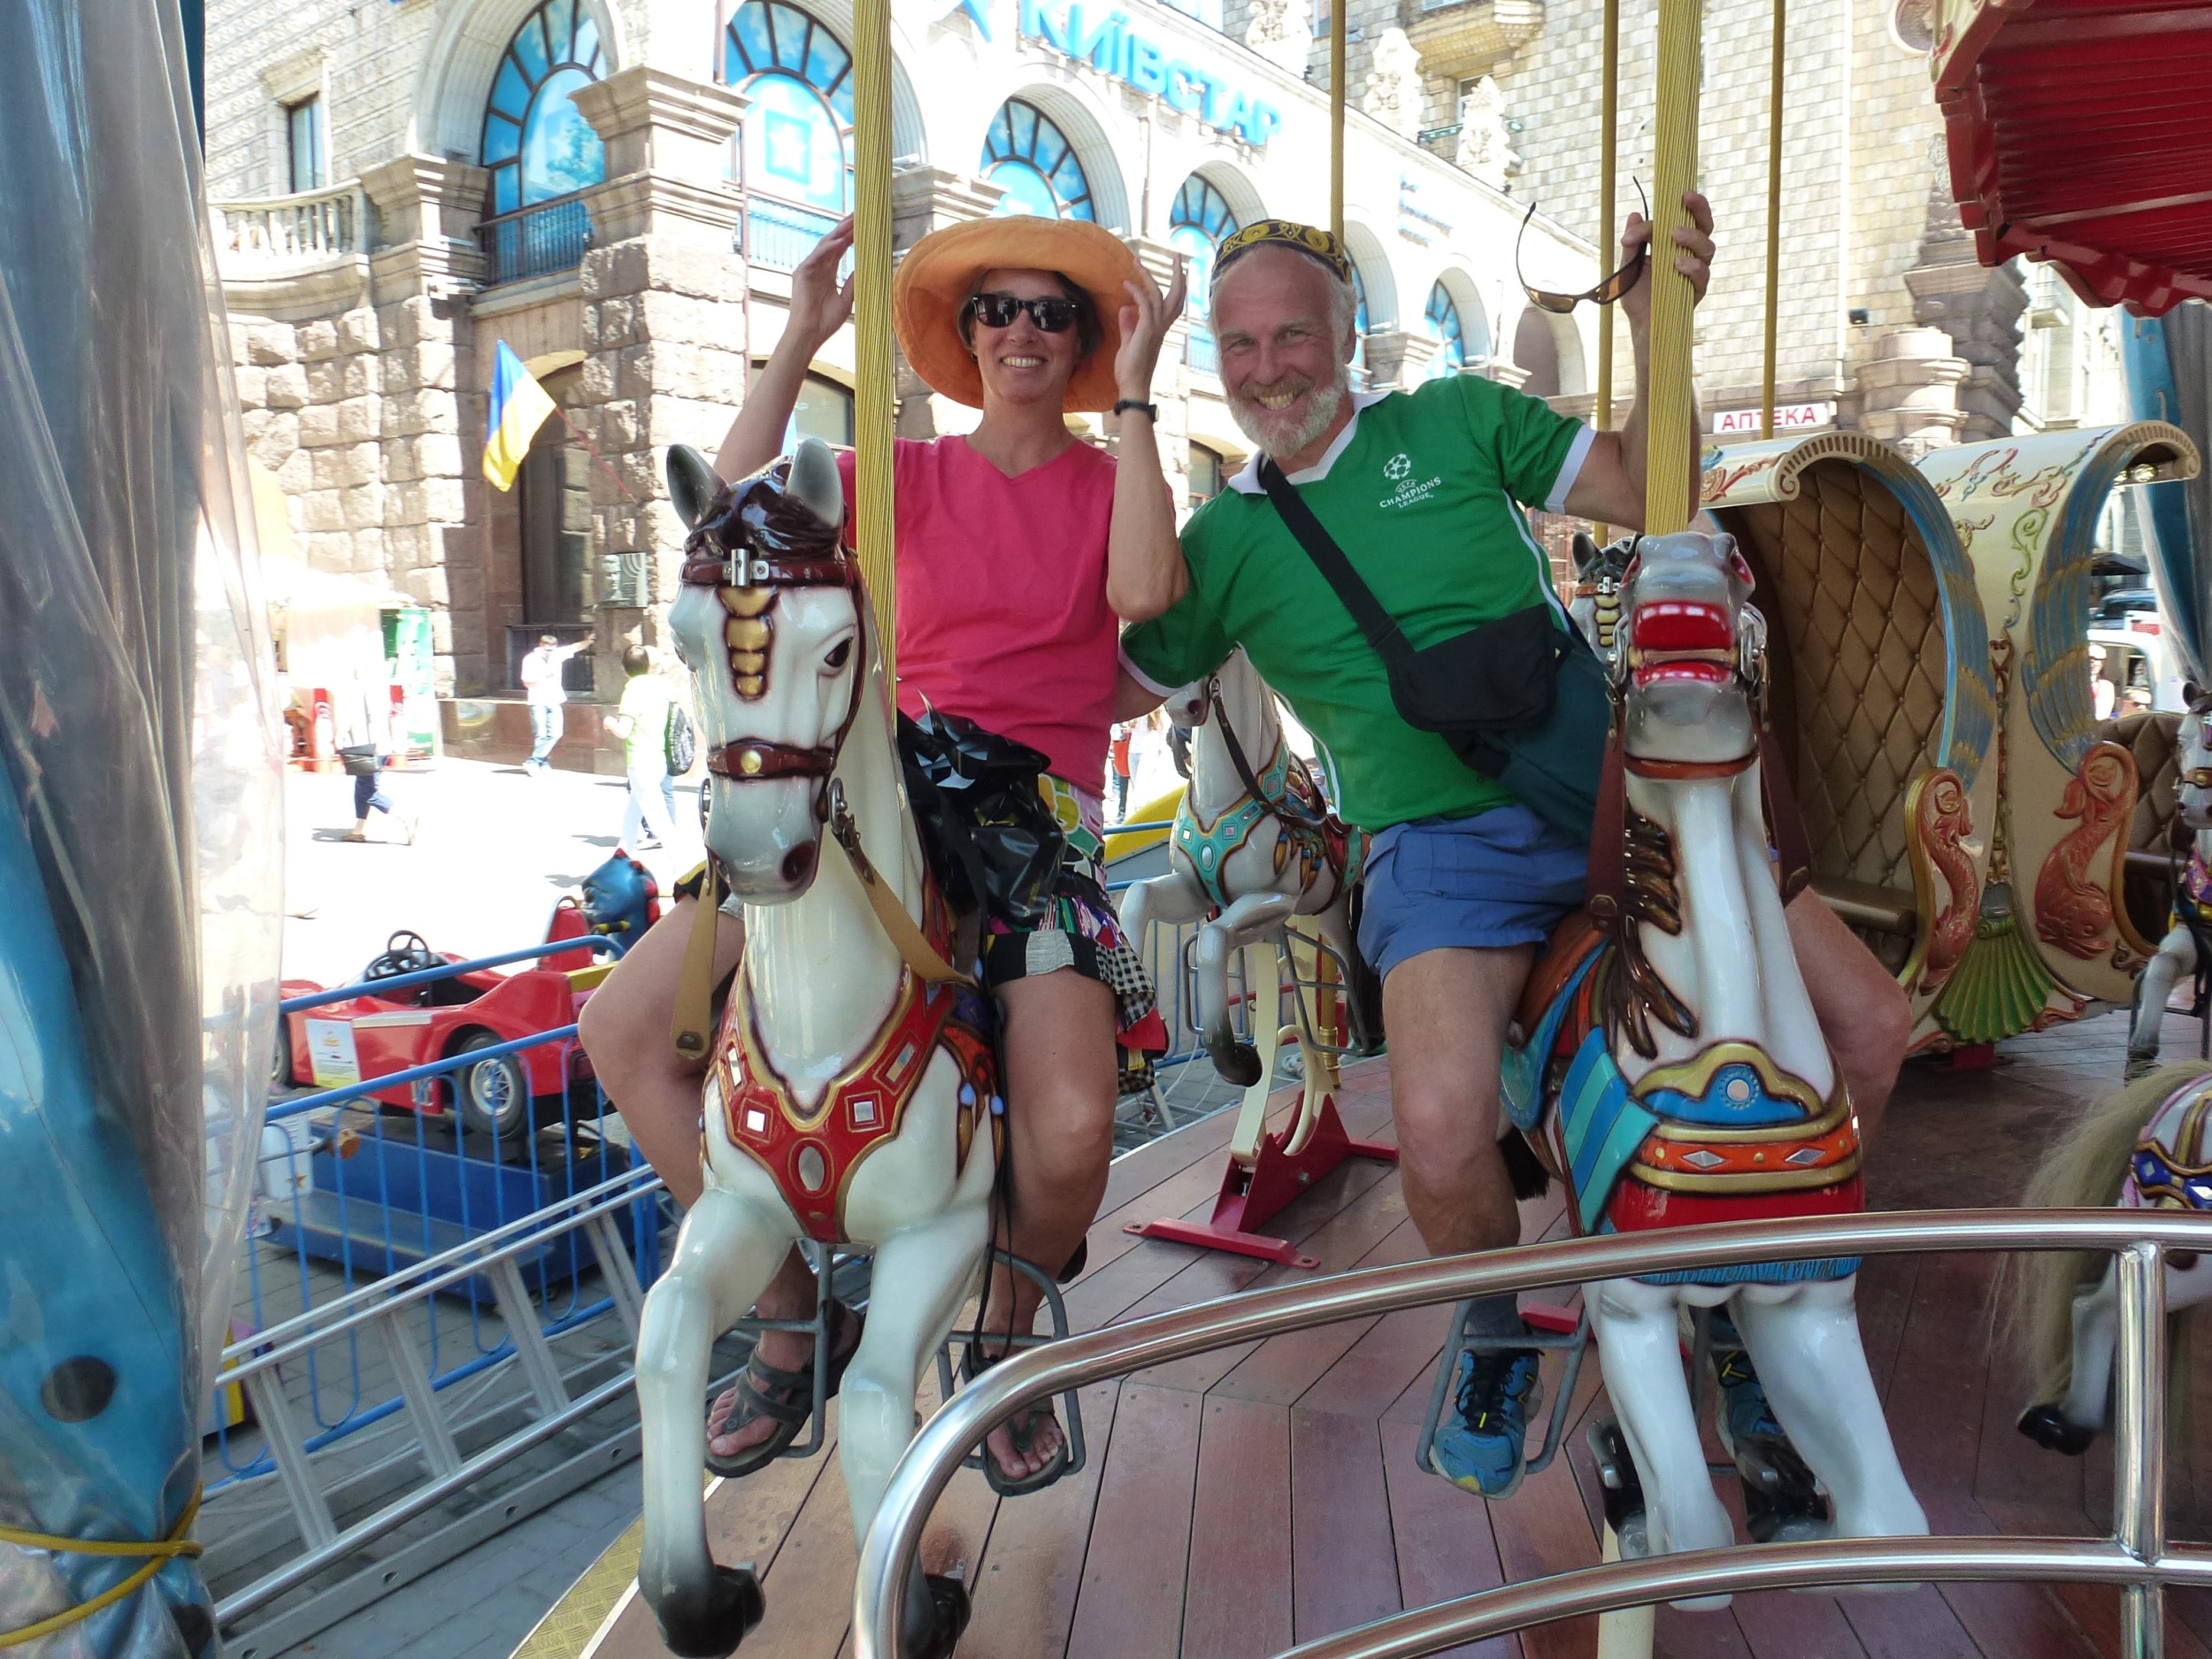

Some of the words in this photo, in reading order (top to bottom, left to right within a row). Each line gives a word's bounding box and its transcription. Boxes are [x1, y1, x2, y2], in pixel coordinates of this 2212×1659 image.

[1018, 0, 1282, 146] КИЇВСТАР
[1379, 477, 1441, 508] CHAMPIONS
[1396, 480, 1416, 493] UEFA
[1398, 492, 1430, 508] LEAGUE
